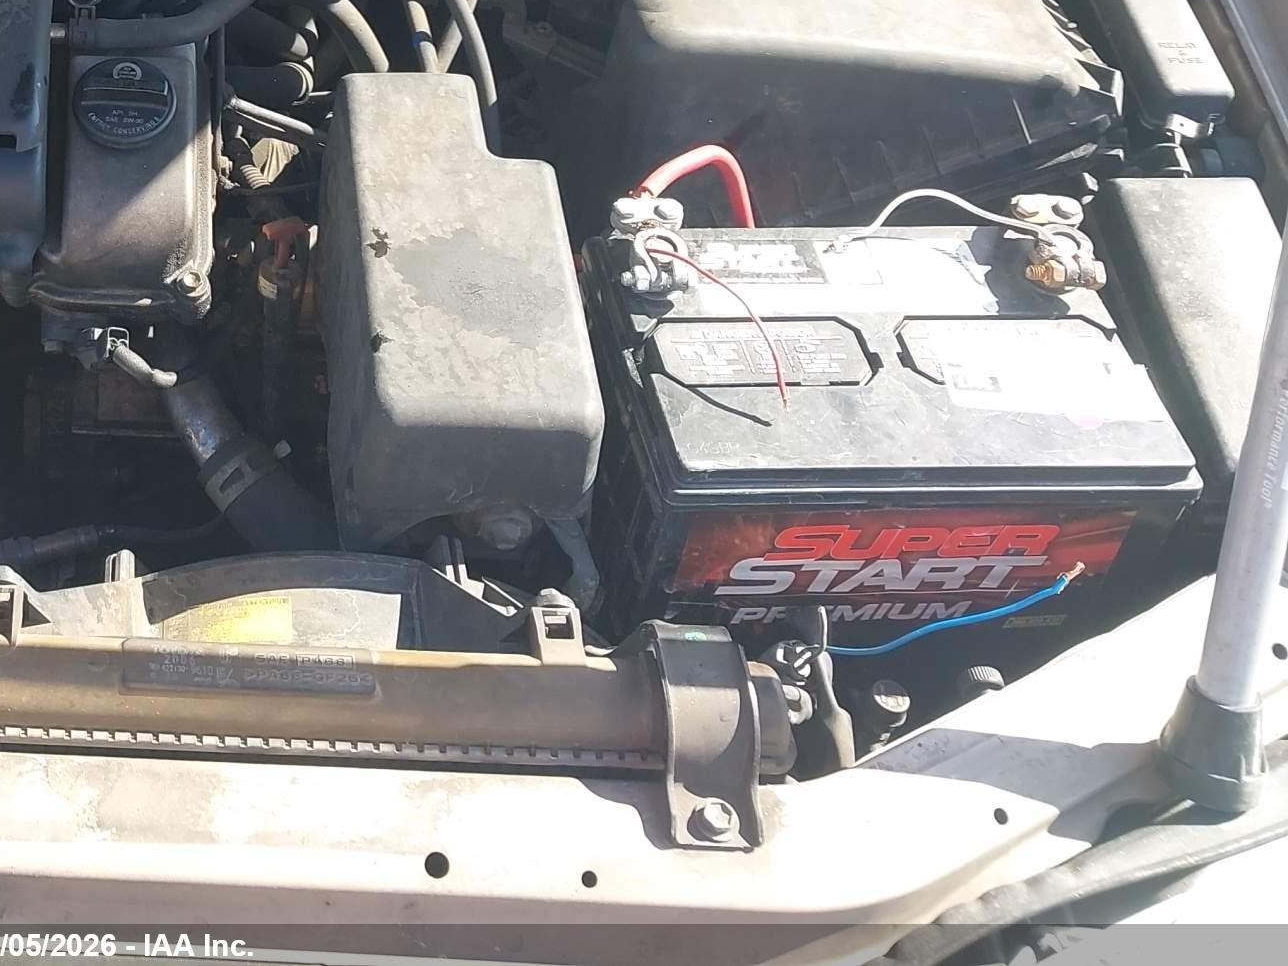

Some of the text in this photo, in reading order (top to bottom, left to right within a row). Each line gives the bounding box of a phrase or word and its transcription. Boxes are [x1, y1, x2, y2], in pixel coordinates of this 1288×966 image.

[763, 523, 1060, 562] SUPER
[713, 554, 1048, 596] START
[729, 600, 972, 625] PRMIUM
